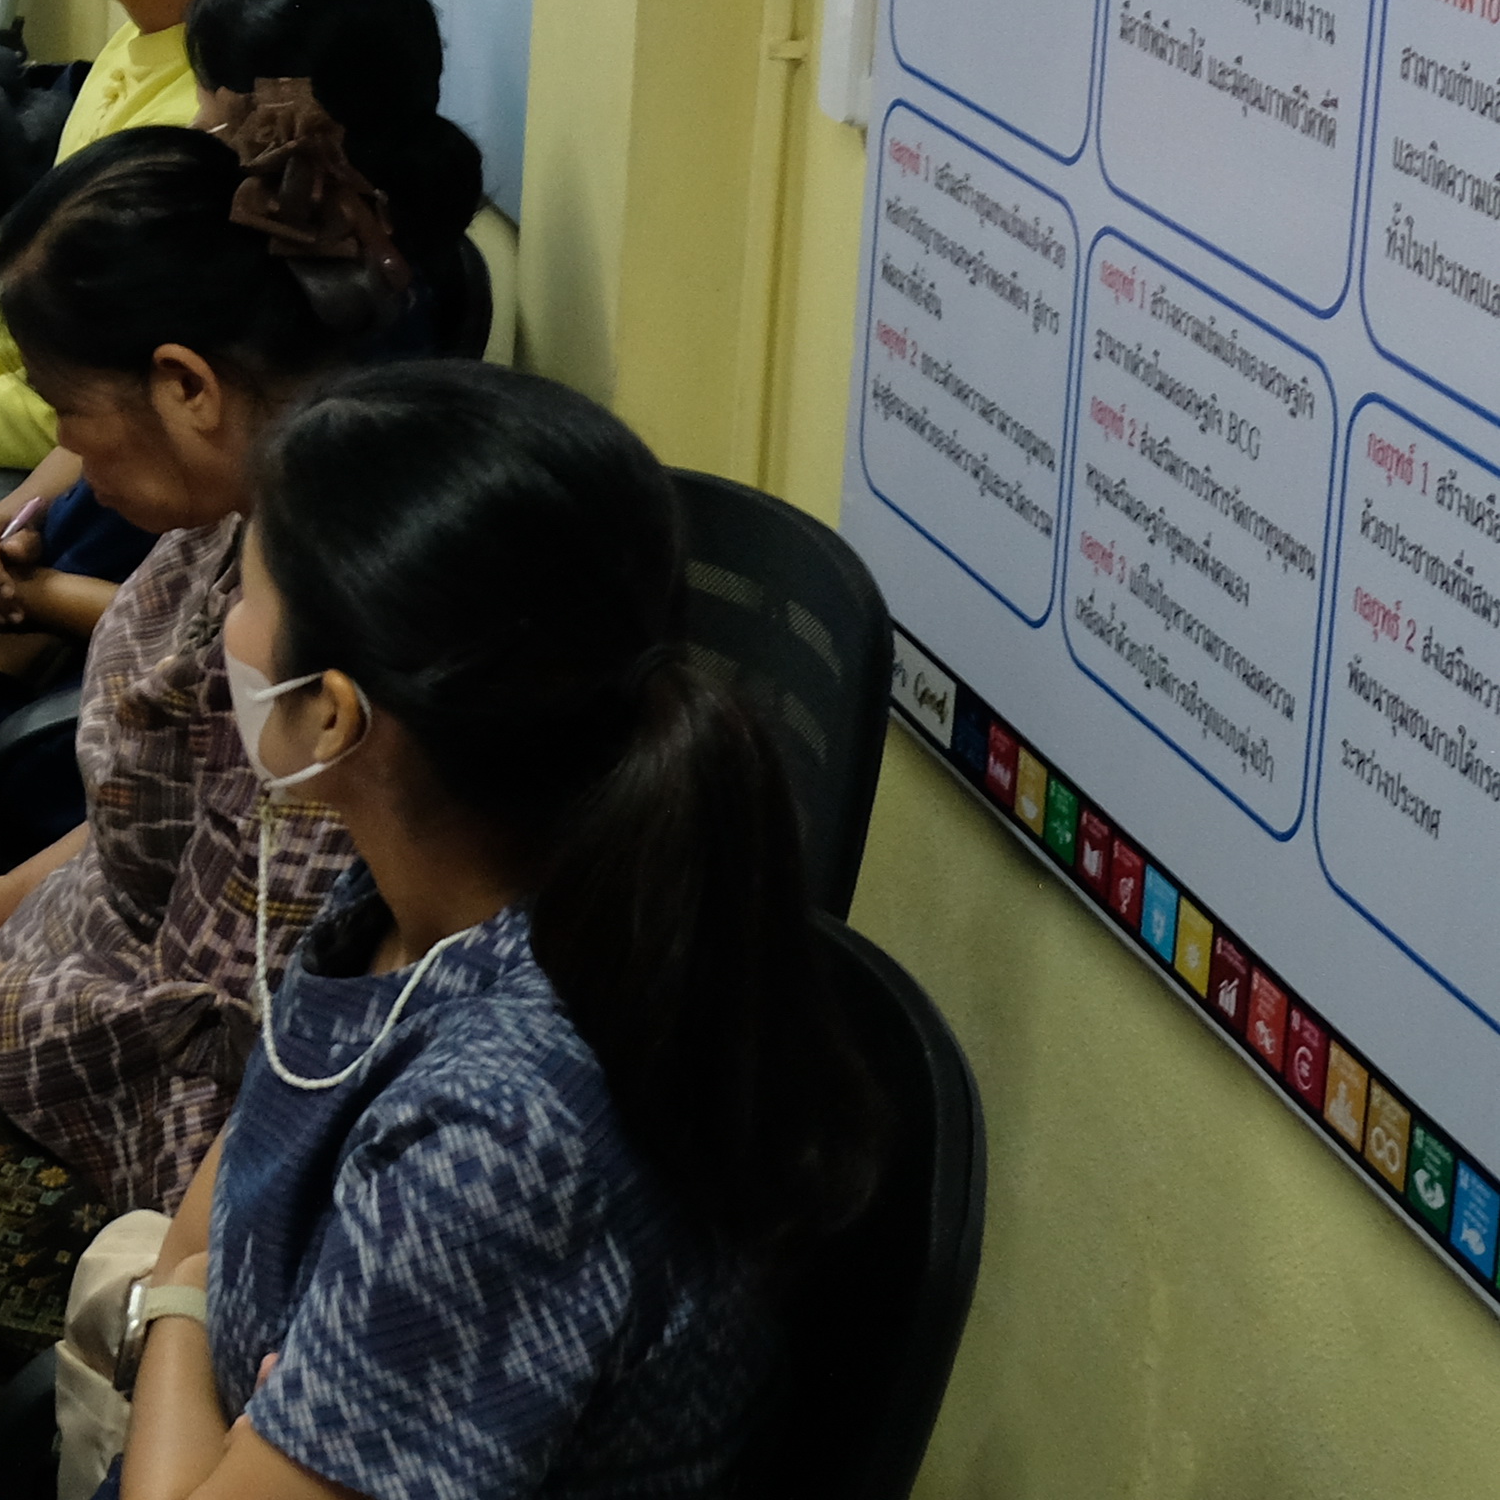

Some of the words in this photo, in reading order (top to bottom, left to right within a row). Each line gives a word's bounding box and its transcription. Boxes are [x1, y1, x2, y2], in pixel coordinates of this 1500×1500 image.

[1098, 257, 1137, 306] กลยุทธ์
[1089, 393, 1127, 442] กลยุทธ์
[1227, 410, 1262, 462] BCG
[1366, 430, 1417, 488] กลยุทธ์
[1080, 528, 1117, 578] กลยุทธ์
[1353, 583, 1403, 645] กลยุทธ์
[1403, 618, 1417, 653] 2
[1340, 737, 1442, 841] ระหว่างประเทศ
